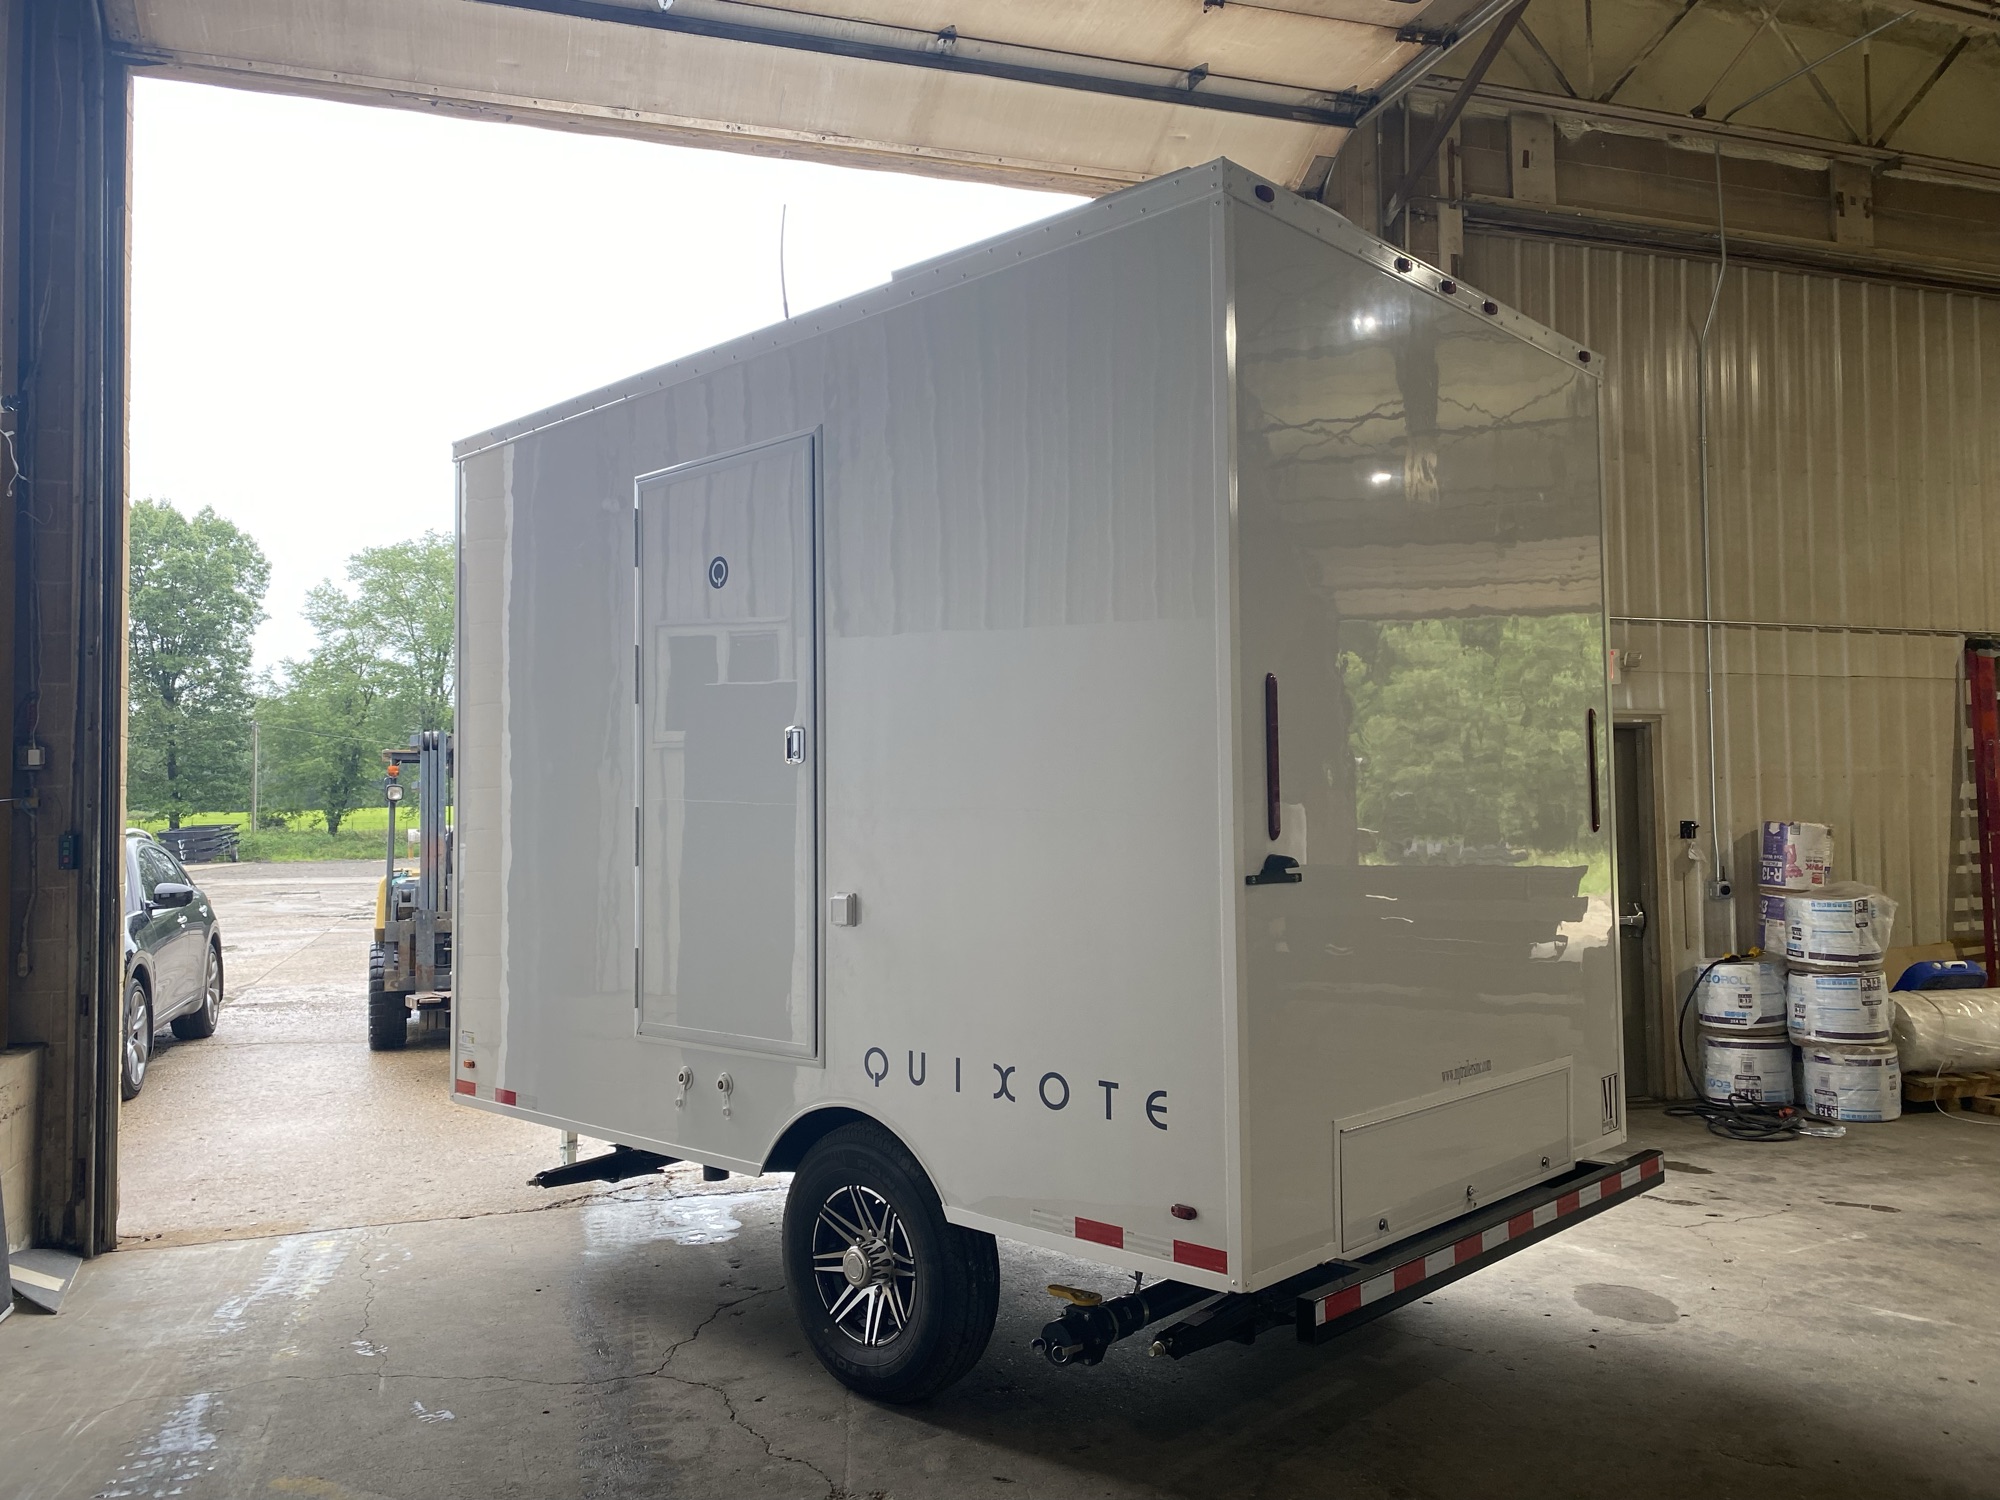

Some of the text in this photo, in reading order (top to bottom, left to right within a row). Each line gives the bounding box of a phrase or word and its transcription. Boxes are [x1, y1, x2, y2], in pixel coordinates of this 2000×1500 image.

[711, 560, 726, 587] Q
[1762, 866, 1783, 882] R-13
[1698, 974, 1752, 985] COROLL
[864, 1046, 1168, 1131] QUIXOTE
